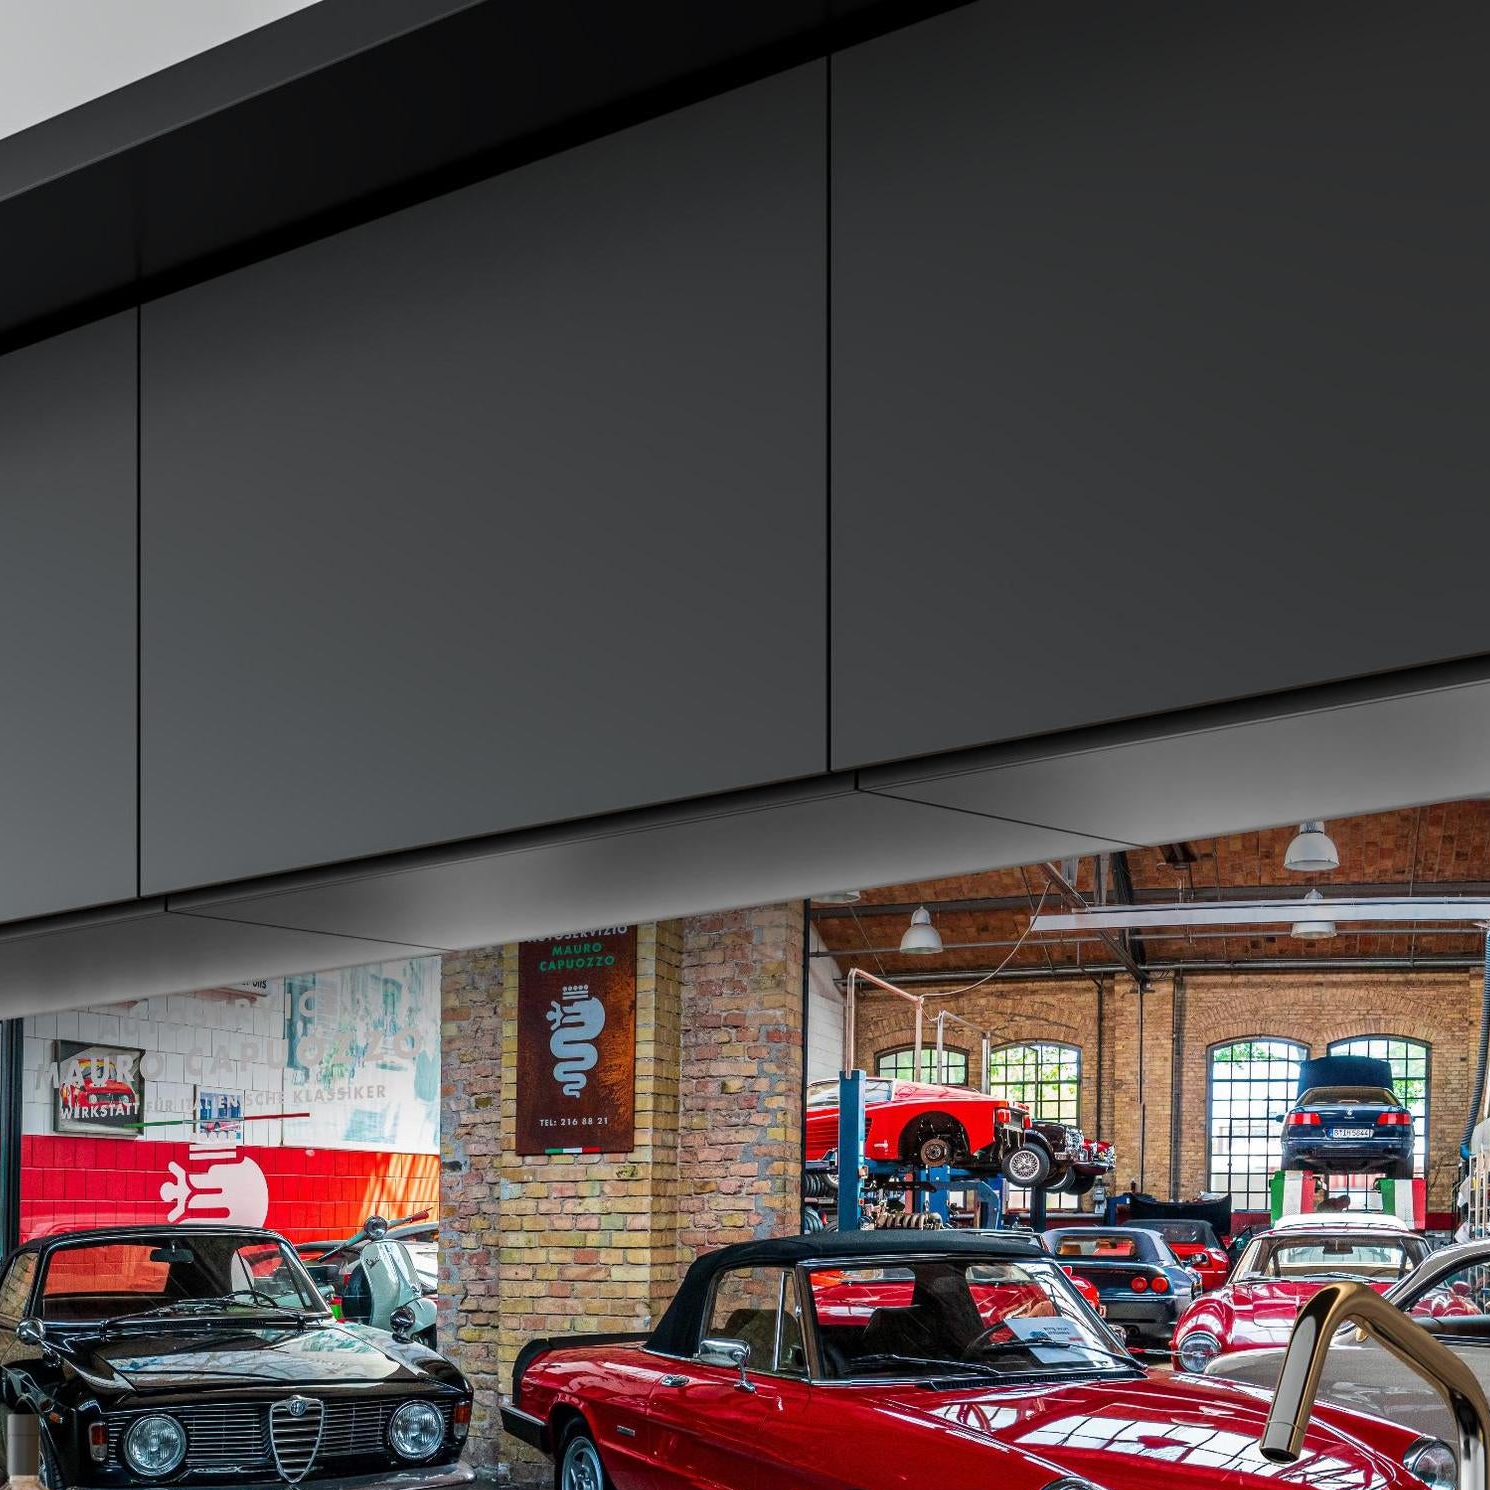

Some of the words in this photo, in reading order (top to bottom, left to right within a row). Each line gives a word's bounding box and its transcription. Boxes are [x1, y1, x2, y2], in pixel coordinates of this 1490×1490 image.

[552, 943, 602, 956] MAURO
[539, 955, 614, 971] CAPUOZZO
[36, 1053, 165, 1089] MAURO
[185, 1029, 424, 1077] CAPUOZZO
[61, 1102, 141, 1120] WERKSTATT
[147, 1098, 171, 1113] FÜR
[293, 1084, 387, 1104] KLASSIKER
[539, 1119, 557, 1127] TEL:
[560, 1118, 578, 1126] 216
[581, 1117, 593, 1125] 88
[597, 1117, 608, 1125] 21
